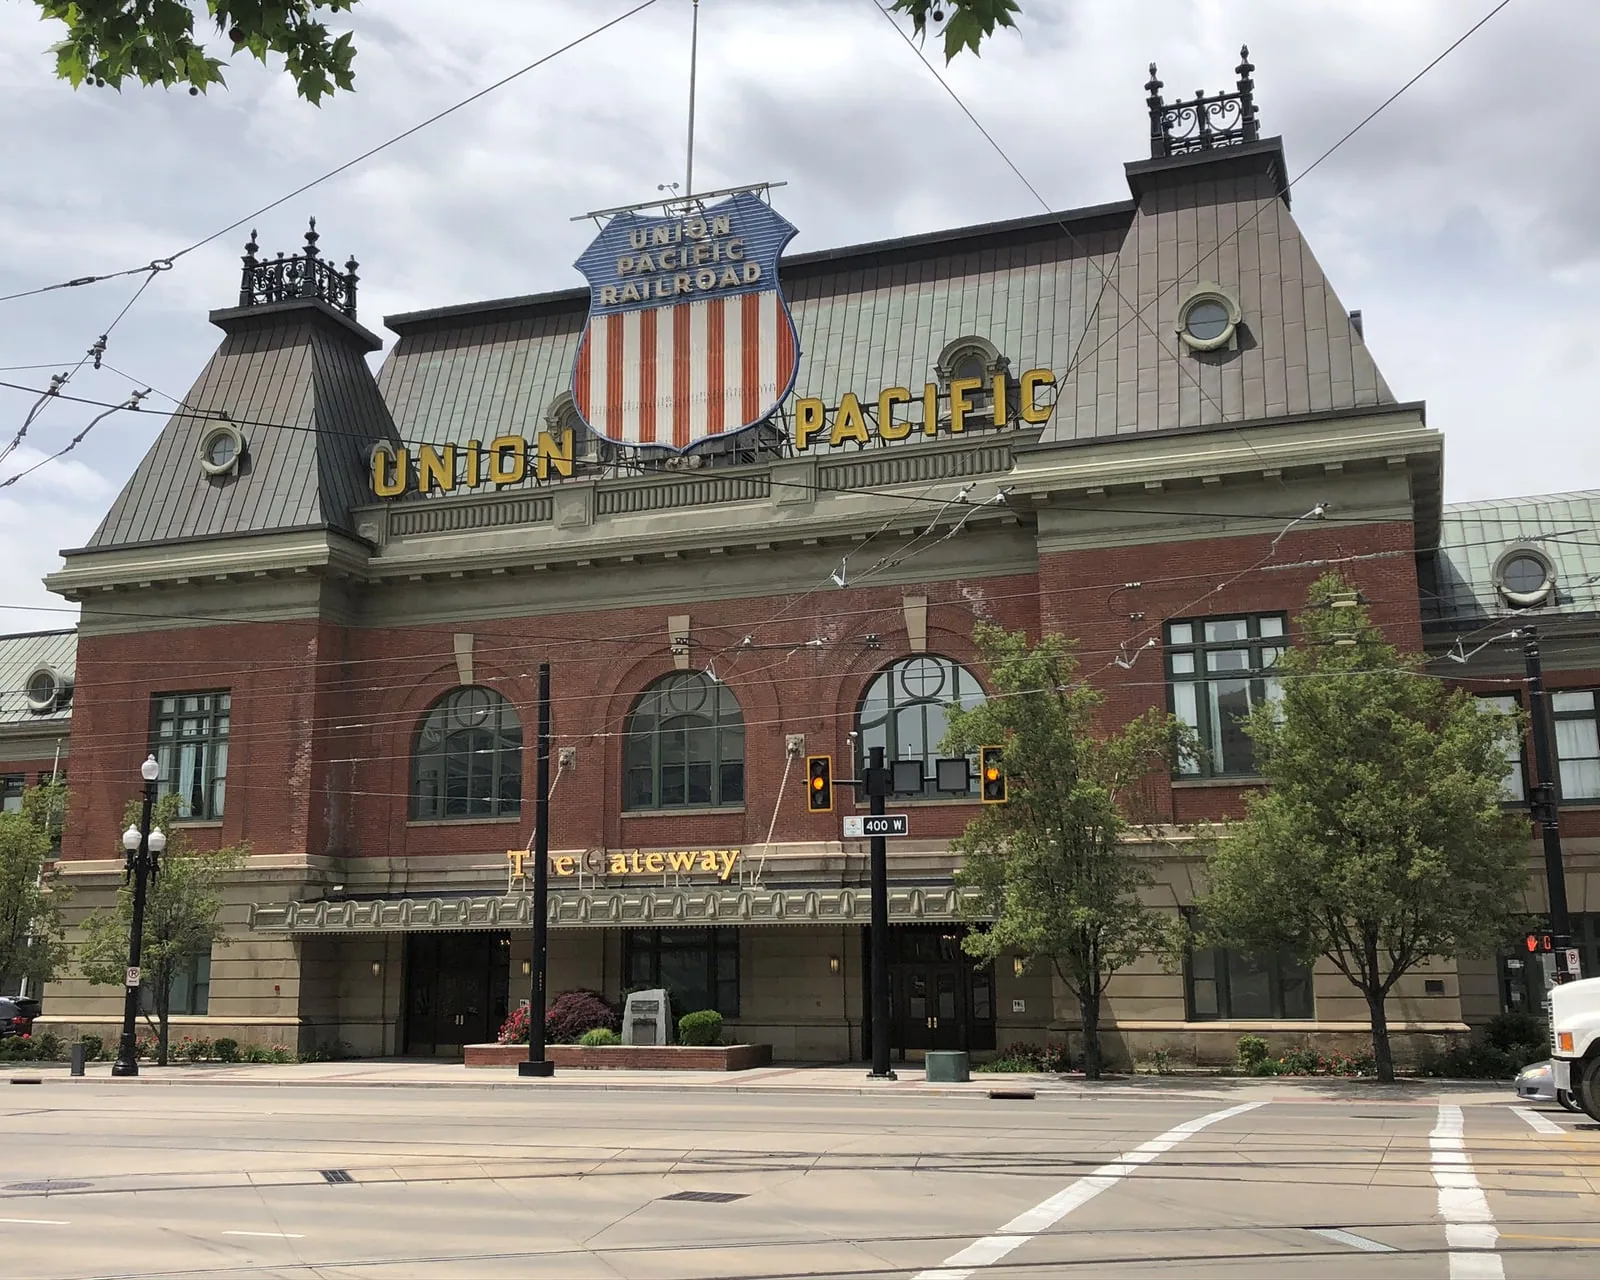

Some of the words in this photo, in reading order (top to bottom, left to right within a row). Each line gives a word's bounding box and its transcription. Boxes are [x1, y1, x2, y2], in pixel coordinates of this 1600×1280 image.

[629, 213, 730, 249] UNION
[616, 237, 744, 276] PACIFIC
[600, 261, 761, 305] RAILROAD
[374, 427, 576, 498] UNION
[795, 368, 1057, 449] PACIFIC
[866, 820, 888, 831] 400
[581, 848, 741, 881] Gateway
